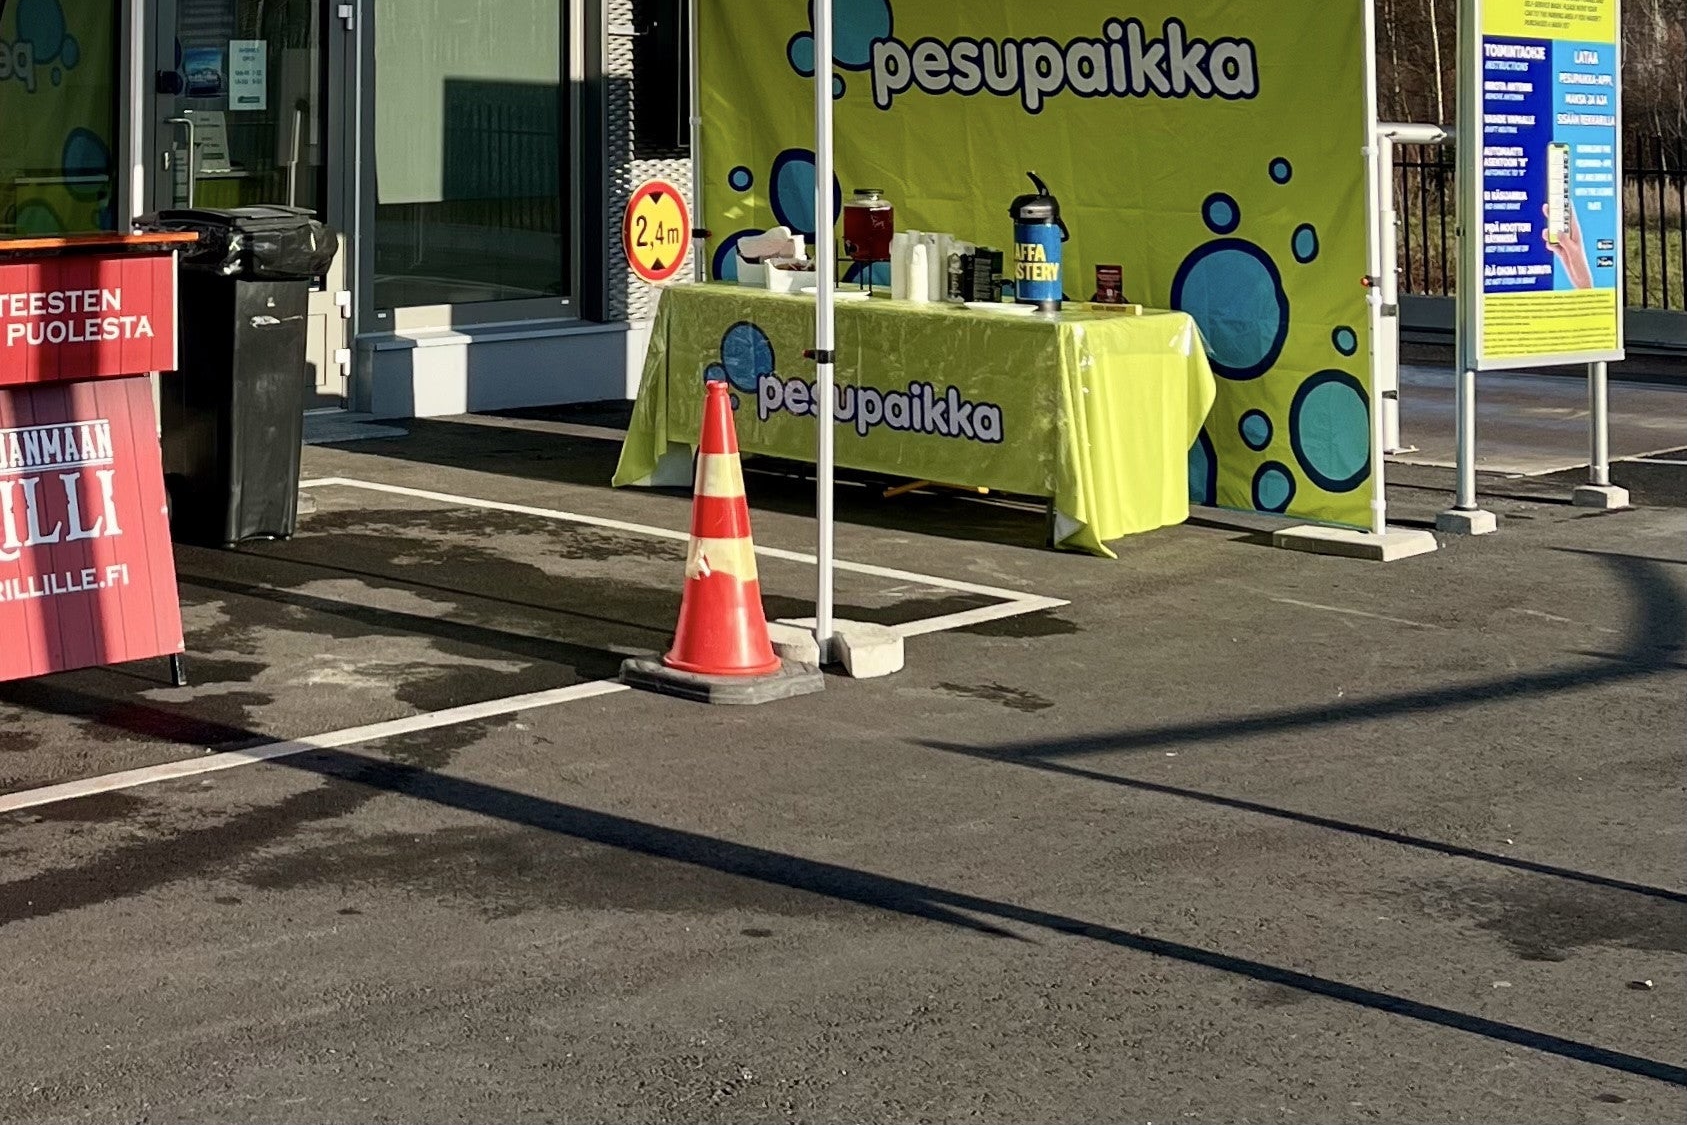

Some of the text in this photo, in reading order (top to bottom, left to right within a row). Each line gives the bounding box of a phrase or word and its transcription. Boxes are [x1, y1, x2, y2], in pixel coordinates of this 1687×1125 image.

[871, 17, 1259, 114] pesupaikka
[6, 314, 155, 347] PUOLESTA
[0, 469, 124, 562] ILLI
